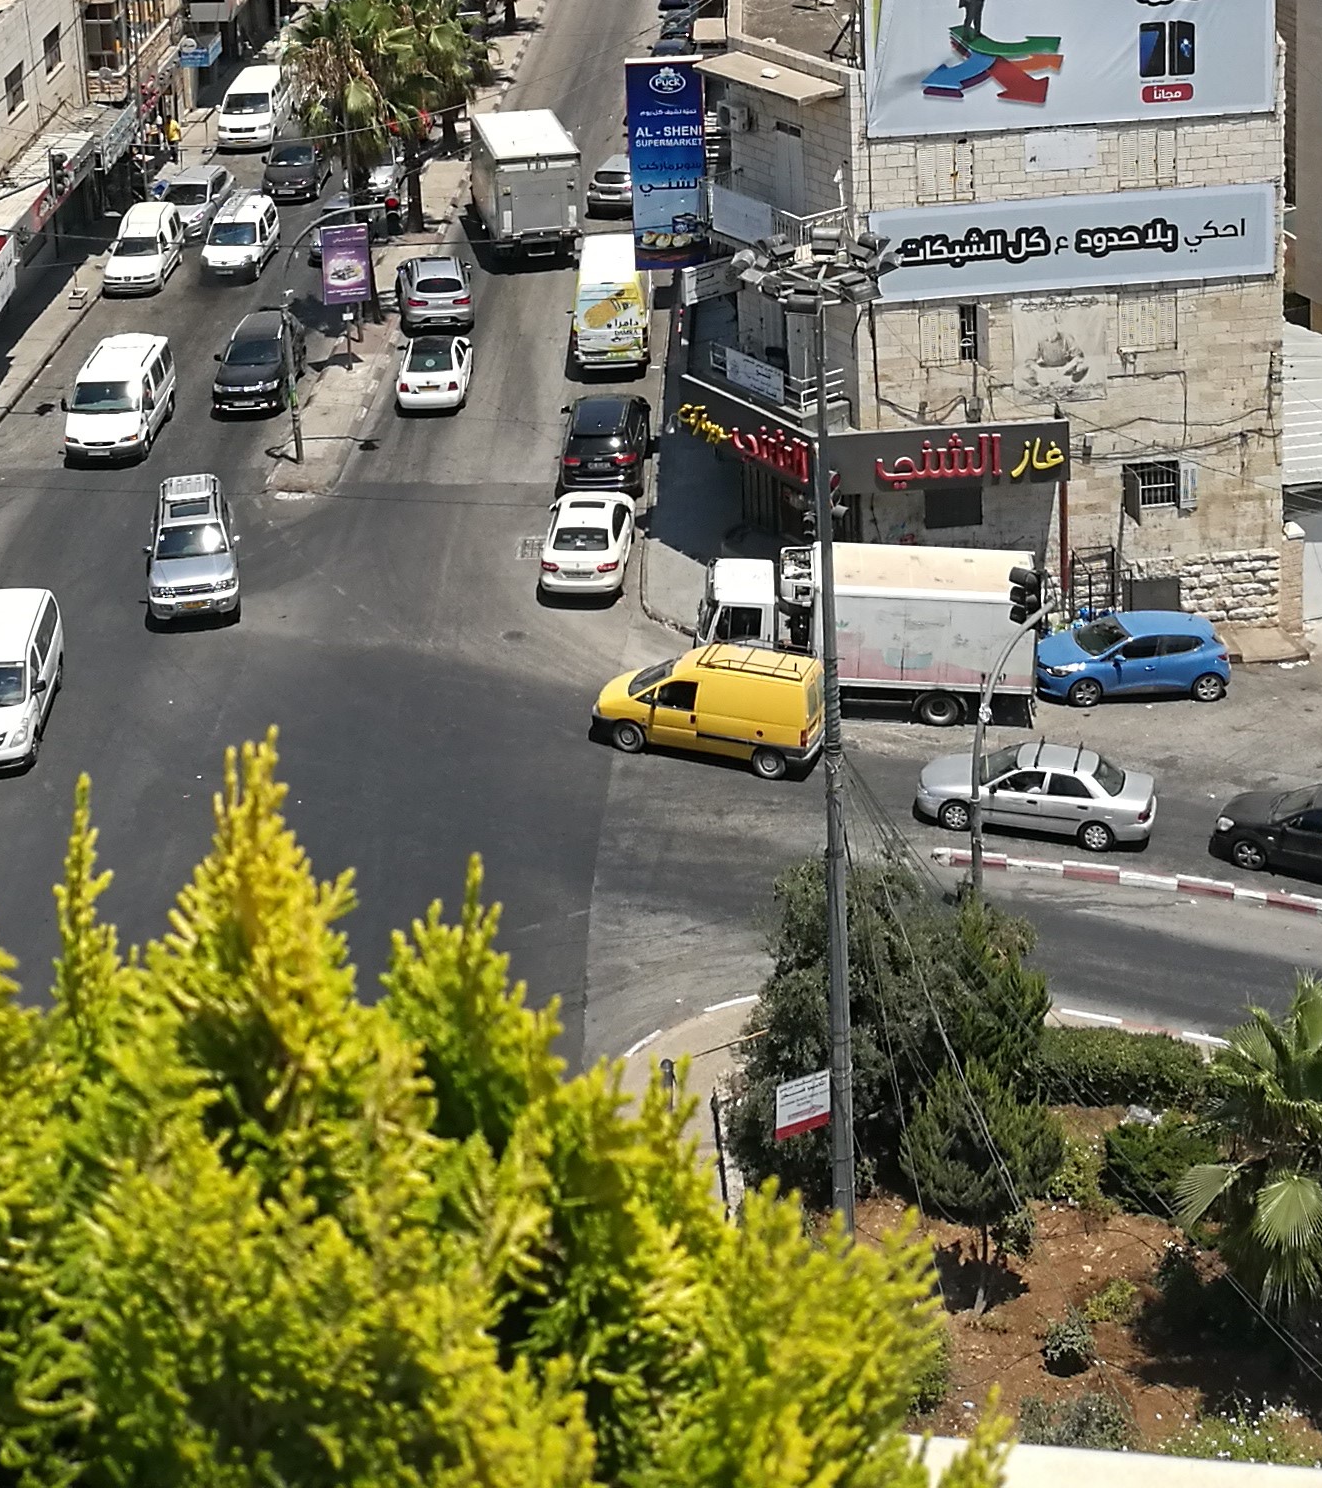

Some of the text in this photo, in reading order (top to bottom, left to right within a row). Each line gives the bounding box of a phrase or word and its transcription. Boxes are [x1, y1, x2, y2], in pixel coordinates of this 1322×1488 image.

[635, 126, 654, 138] AL
[663, 124, 703, 137] SHENI
[635, 137, 704, 148] SUPERMARKET
[639, 174, 699, 197] لشني
[1007, 231, 1046, 259] كل
[1080, 230, 1140, 253] حدود
[1145, 223, 1173, 247] بلا
[1184, 218, 1246, 254] احكي
[902, 232, 1003, 263] الشبكات
[876, 431, 1065, 490] غاز الشني
